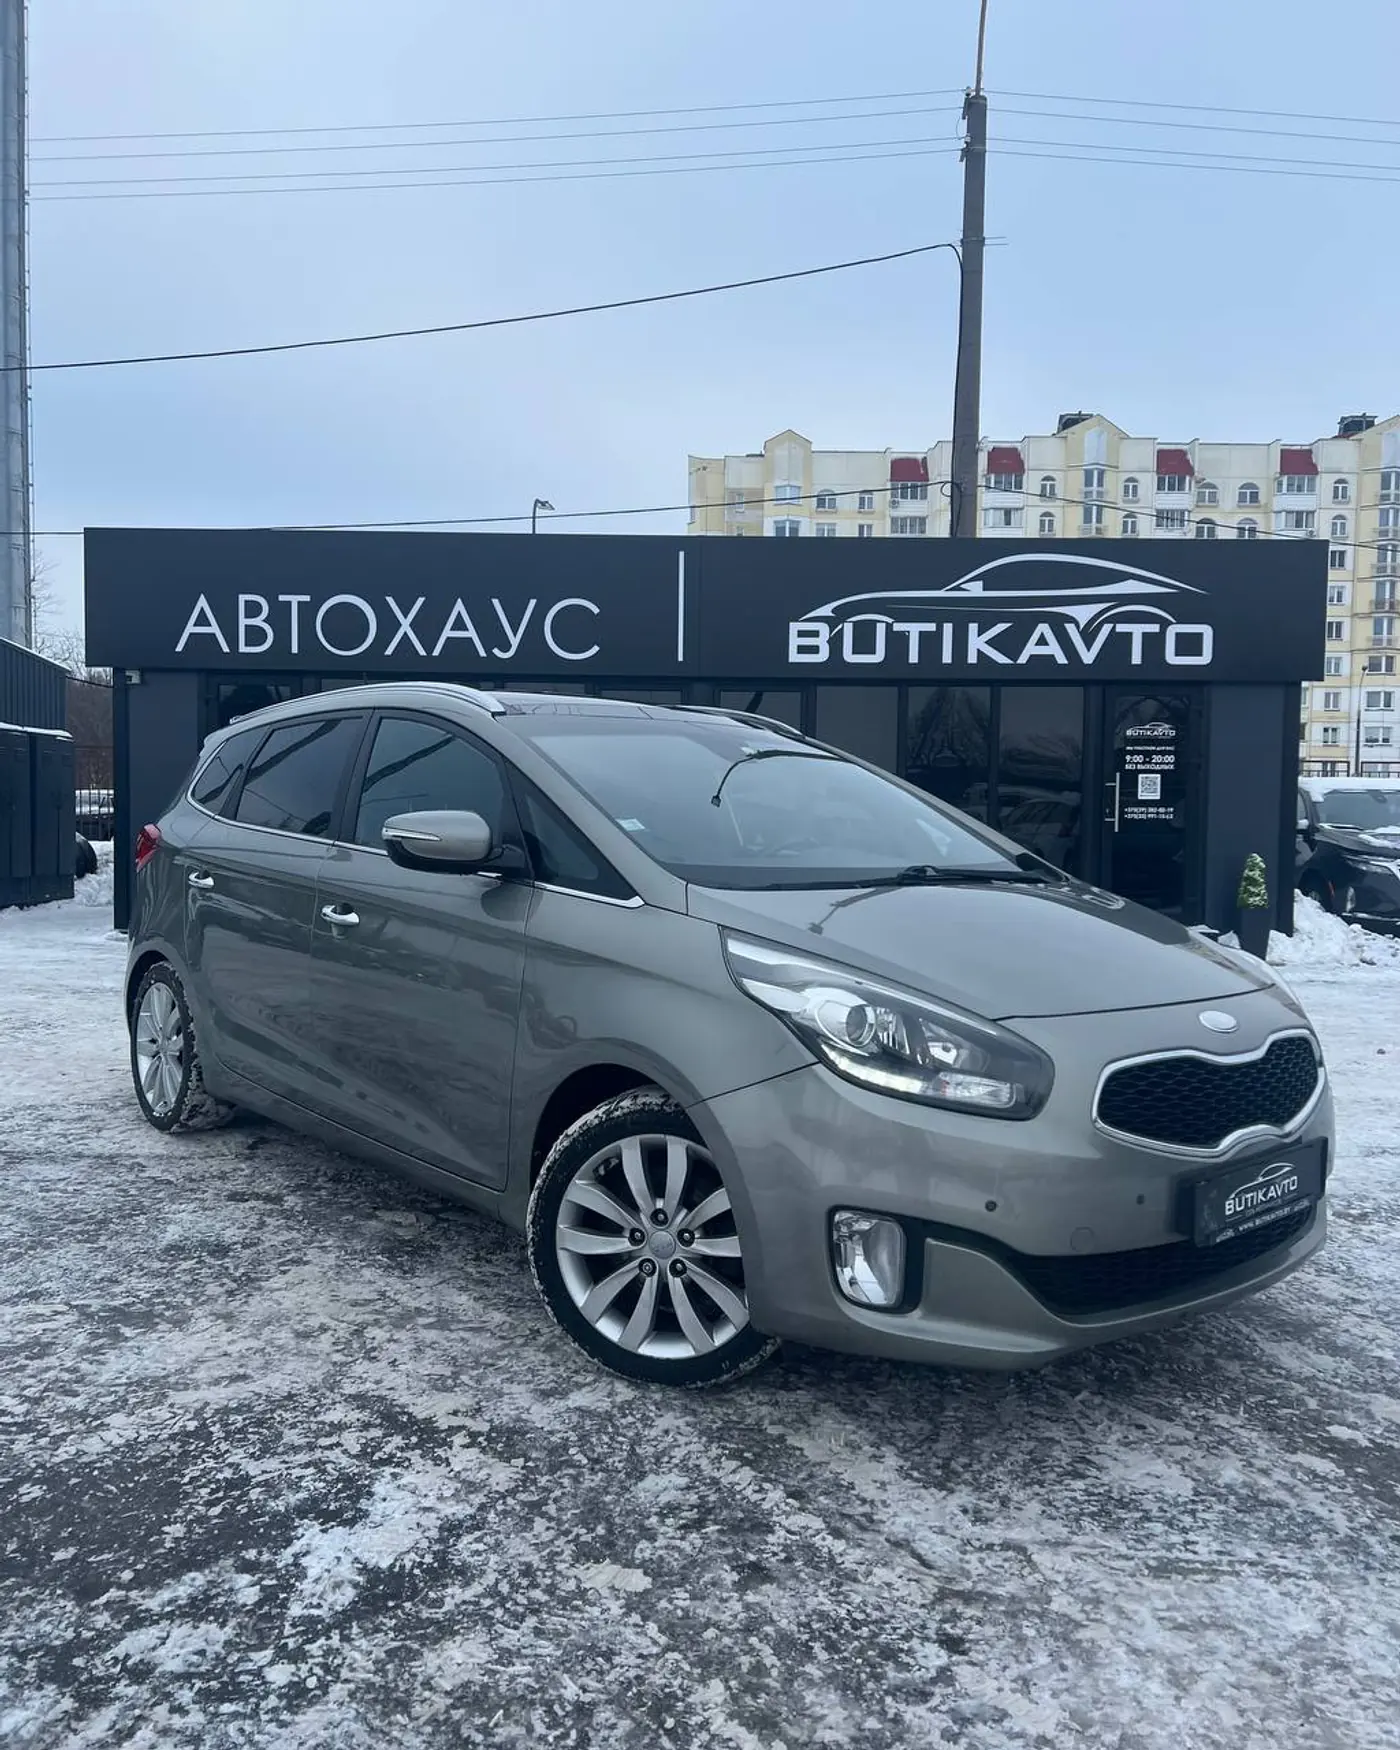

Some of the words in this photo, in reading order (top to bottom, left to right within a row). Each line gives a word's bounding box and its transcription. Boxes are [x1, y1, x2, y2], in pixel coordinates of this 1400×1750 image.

[175, 594, 601, 660] АВТОХАУС
[788, 622, 1214, 666] BUTIKAVTO
[1125, 755, 1144, 763] 9:00
[1151, 755, 1175, 763] 20:00
[1225, 1176, 1298, 1216] BUTIKAVTO
